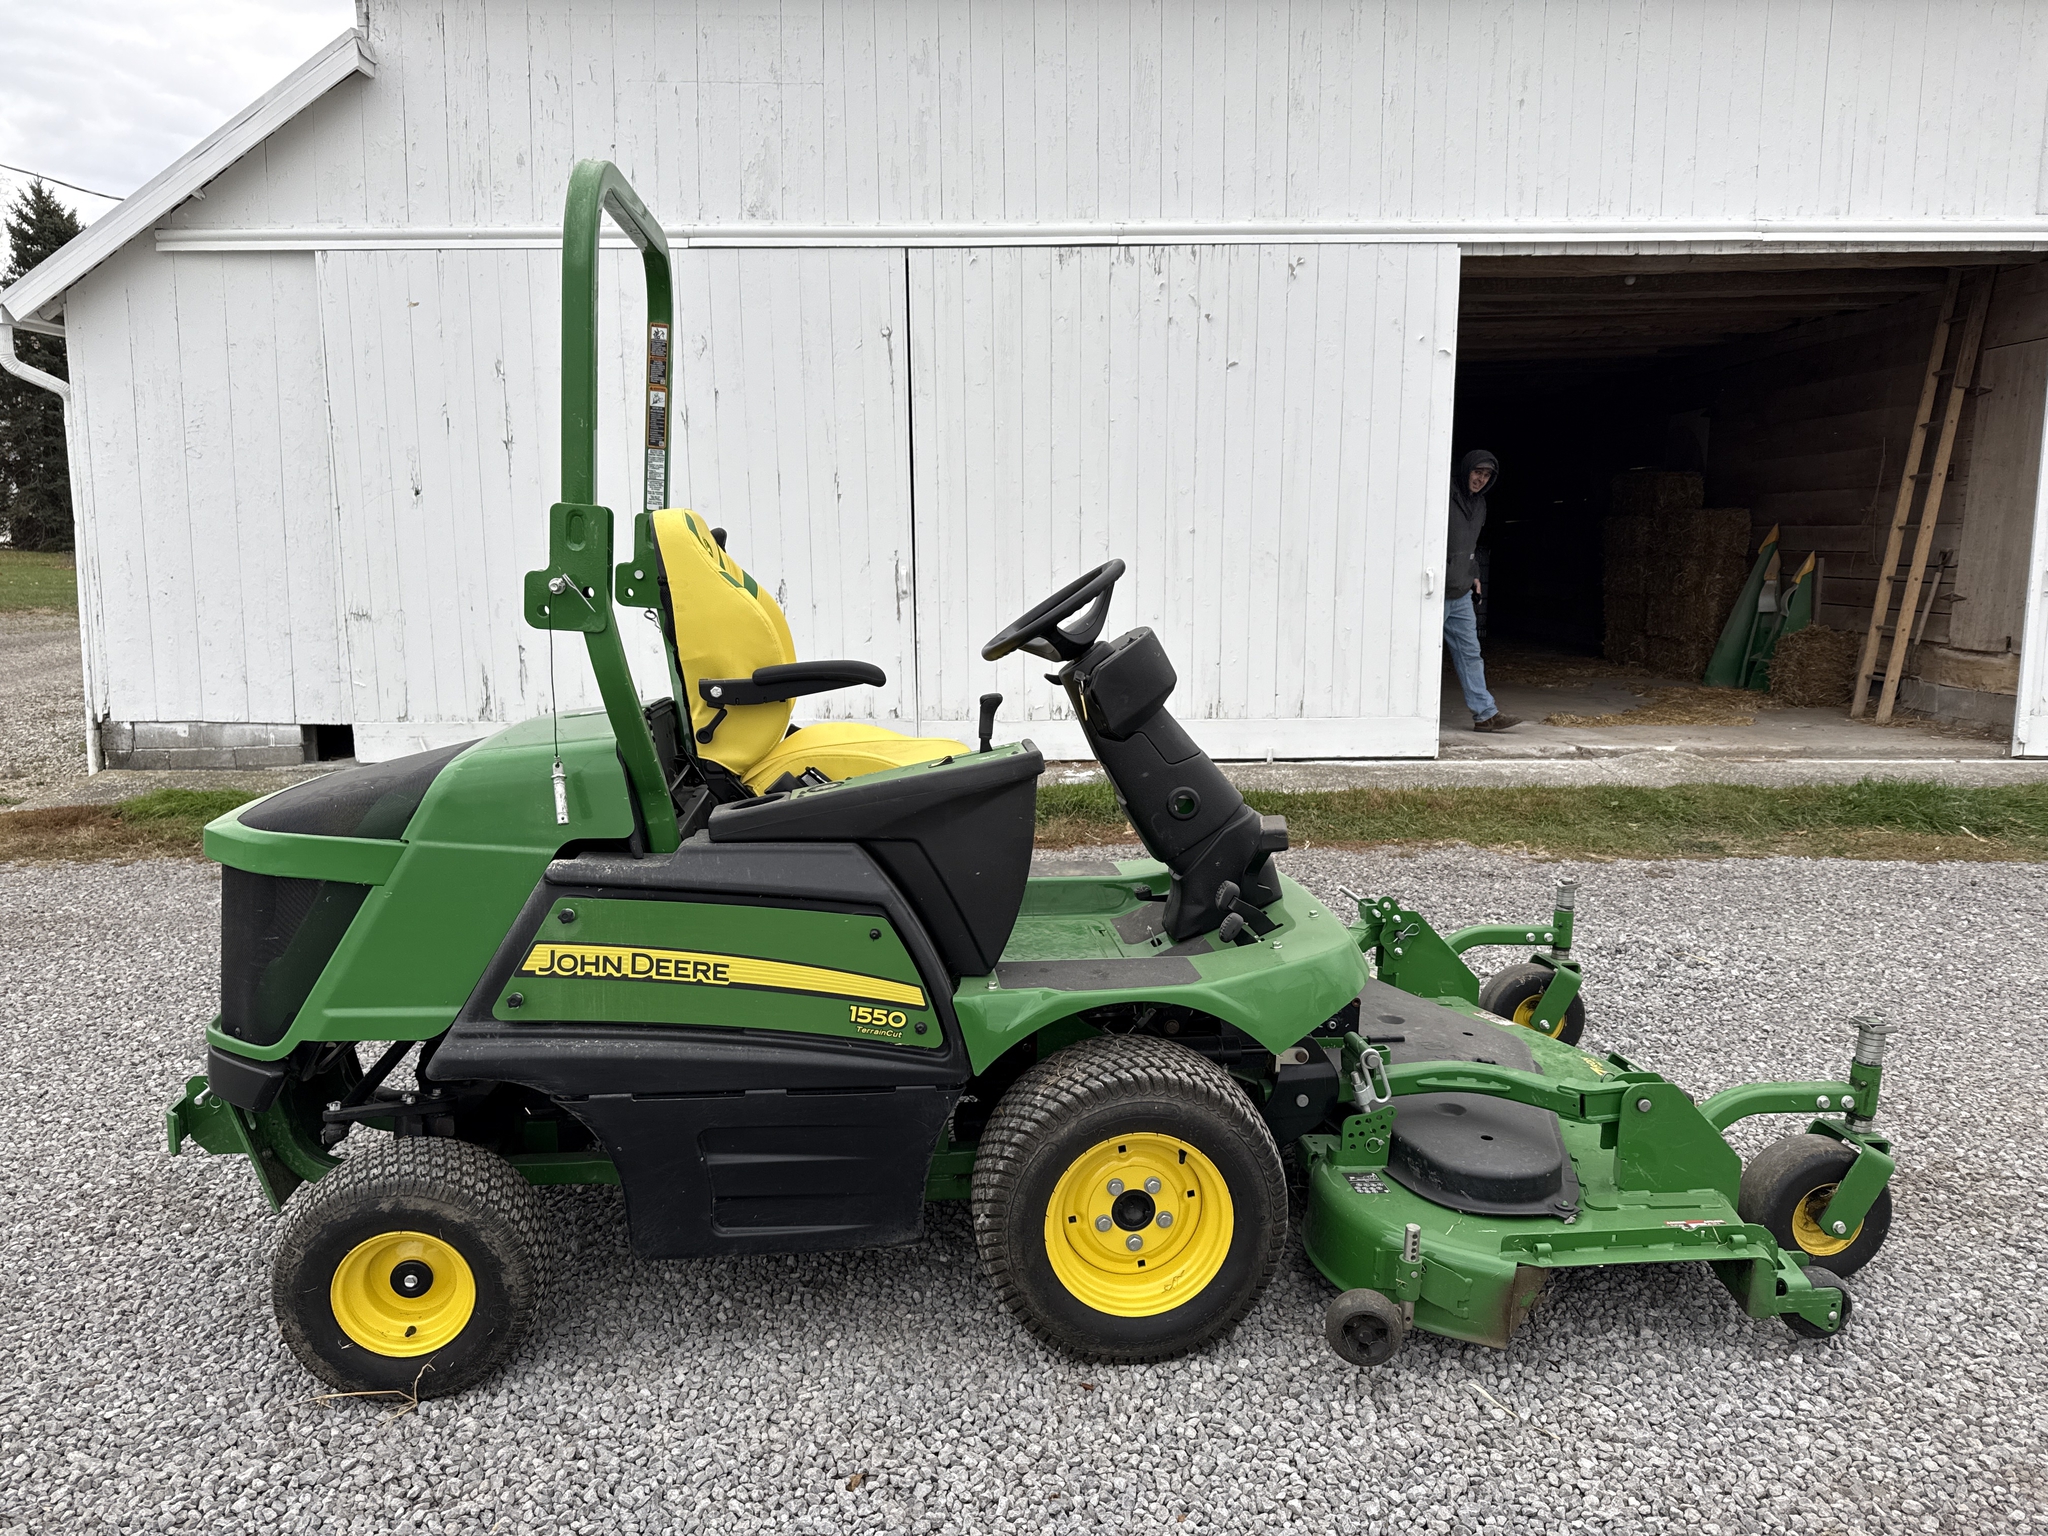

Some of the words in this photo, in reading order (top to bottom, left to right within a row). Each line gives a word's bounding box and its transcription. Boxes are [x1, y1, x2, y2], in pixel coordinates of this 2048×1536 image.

[538, 949, 623, 976] JOHN
[631, 952, 730, 982] DEERE
[849, 1005, 907, 1028] 1550
[856, 1025, 903, 1038] TerrainCut
